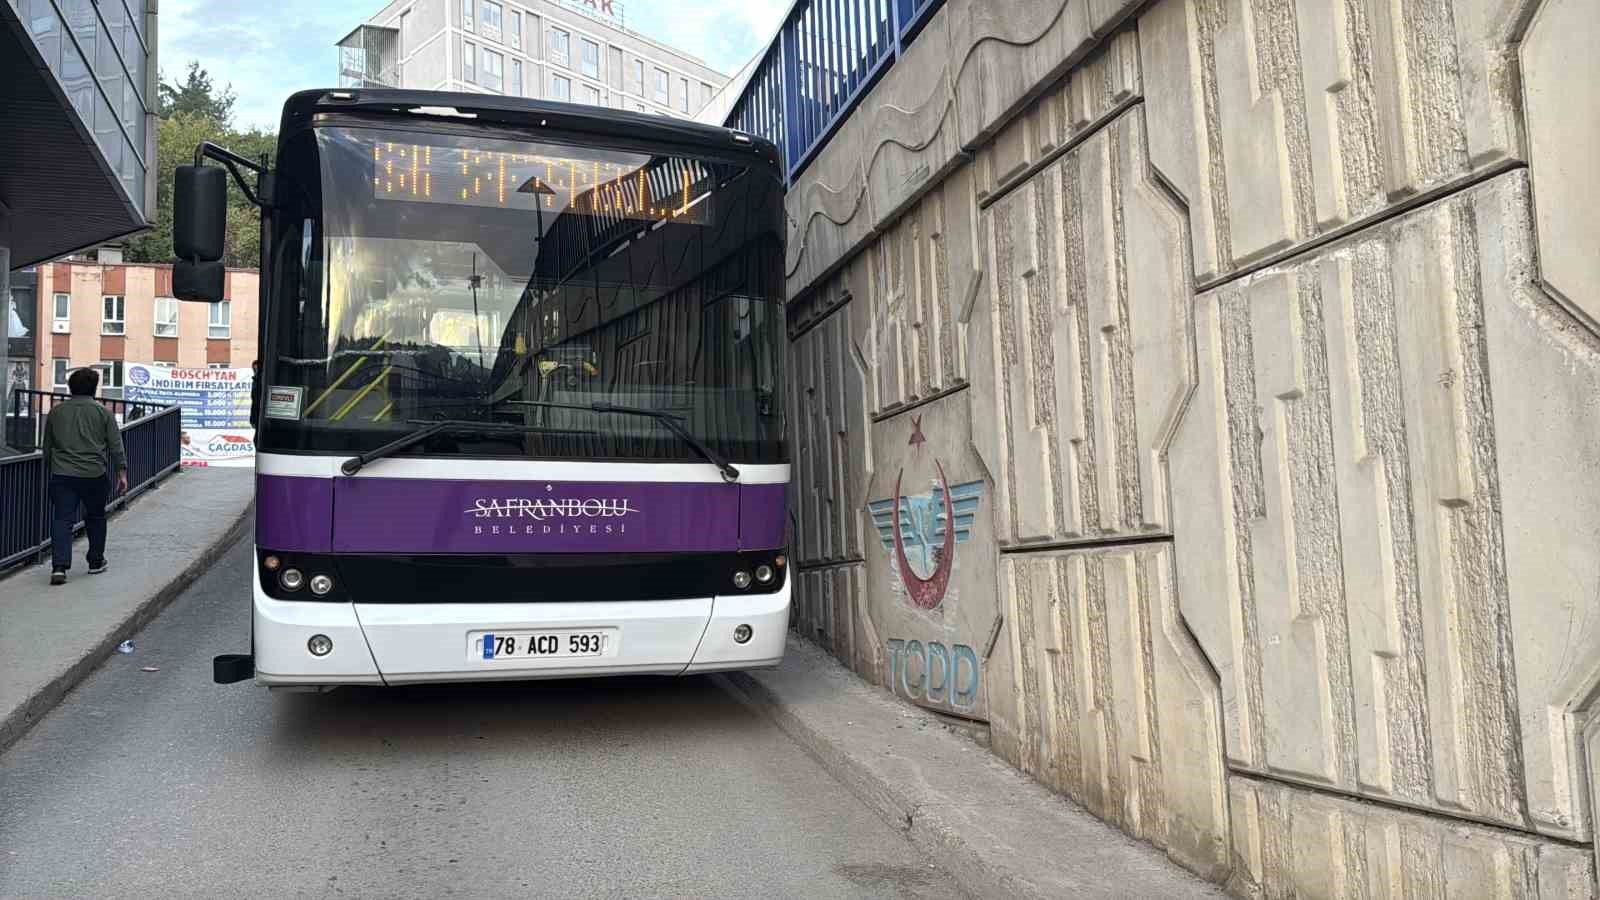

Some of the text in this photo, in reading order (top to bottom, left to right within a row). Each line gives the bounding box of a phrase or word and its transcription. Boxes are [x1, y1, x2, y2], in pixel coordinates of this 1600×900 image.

[474, 498, 628, 520] SAFRANBOLU
[495, 636, 516, 655] 78
[527, 635, 559, 655] ACD
[569, 634, 600, 653] 593
[886, 637, 979, 713] TCDD
